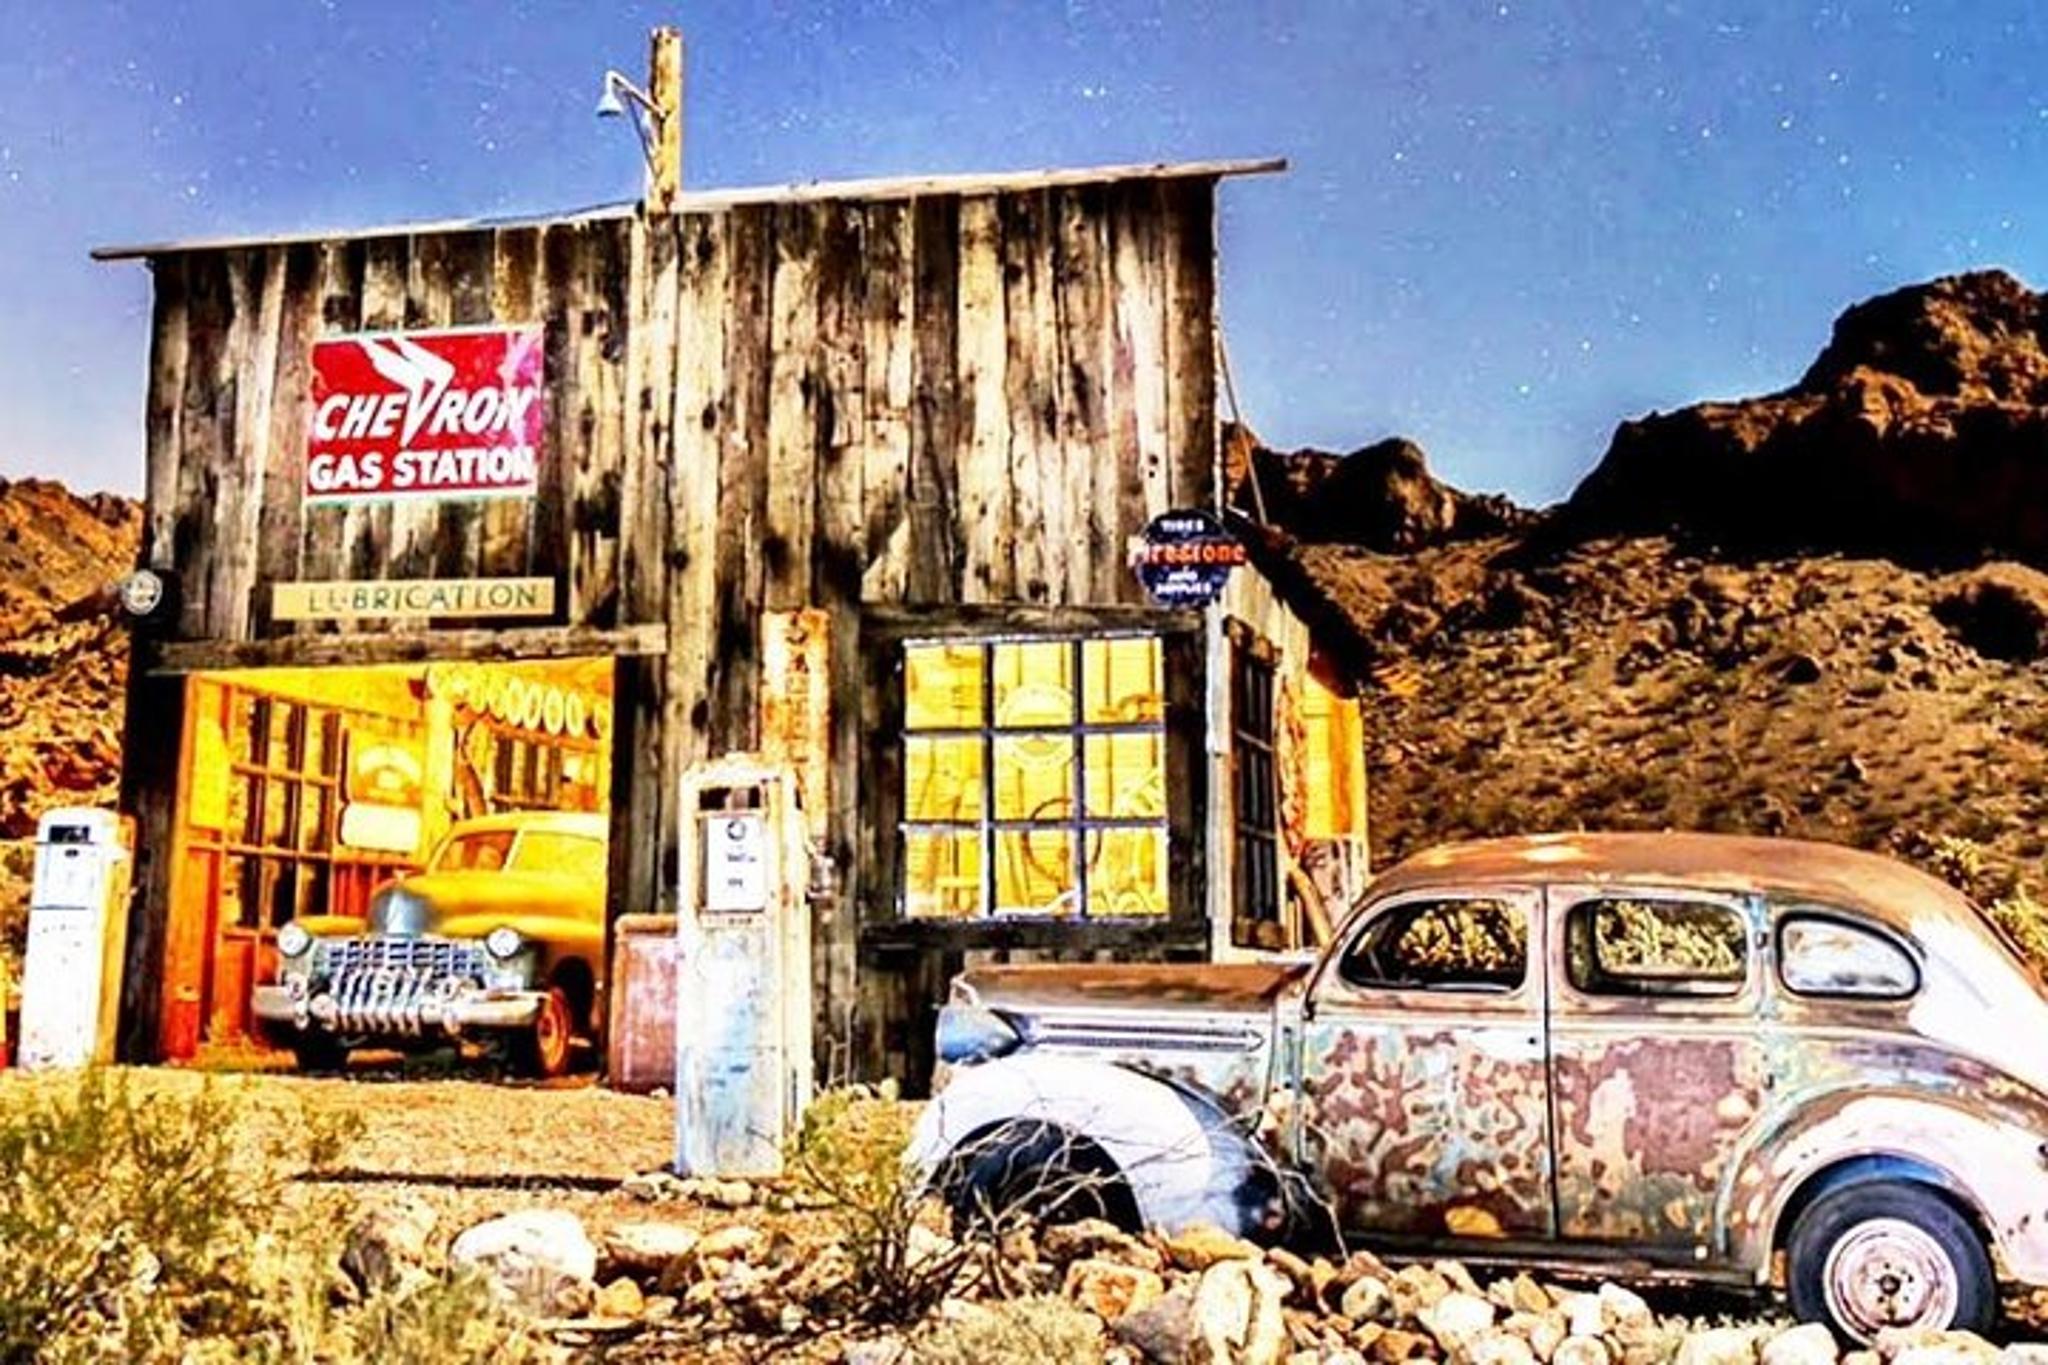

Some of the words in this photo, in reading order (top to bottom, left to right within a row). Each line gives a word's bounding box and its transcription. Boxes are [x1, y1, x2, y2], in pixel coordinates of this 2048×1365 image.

[314, 378, 534, 448] CHEVRON
[309, 452, 383, 490] GAS
[391, 446, 535, 487] STATION
